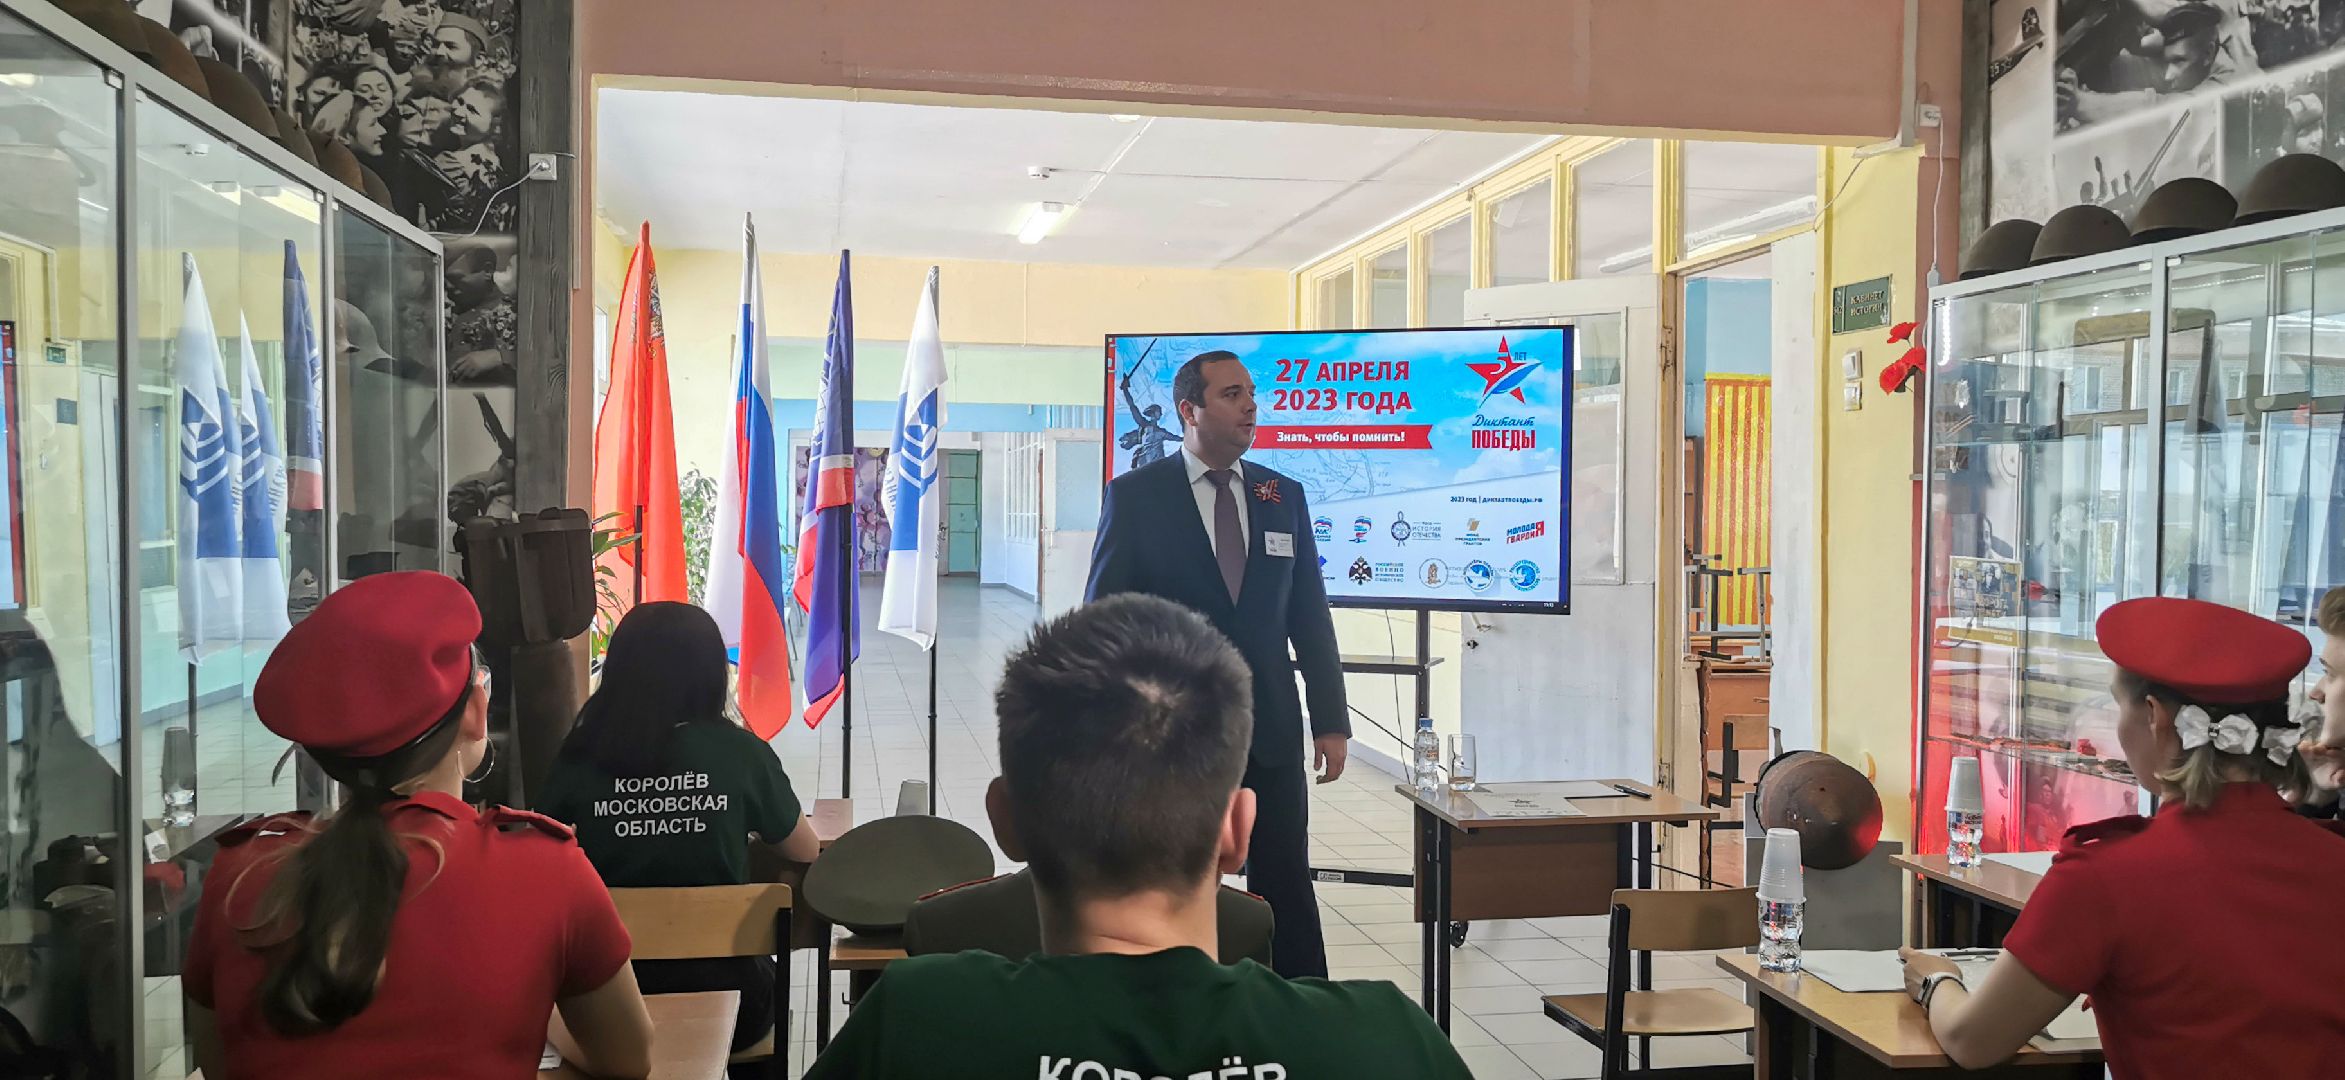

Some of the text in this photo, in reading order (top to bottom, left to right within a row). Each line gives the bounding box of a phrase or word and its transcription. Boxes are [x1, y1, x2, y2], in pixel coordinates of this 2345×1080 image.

[1850, 290, 1884, 304] КАБИНЕТ
[1513, 352, 1527, 361] ЛЕТ
[1275, 359, 1410, 383] 27 АПРЕЛЯ
[1273, 388, 1413, 415] 2023 ГОДА
[1472, 414, 1535, 427] Диктант
[1277, 431, 1405, 443] Знать, чтобы помнить!
[1472, 430, 1535, 451] ПОБЕДЫ
[614, 771, 709, 793] КОРОЛЁВ
[594, 795, 728, 817] МОСКОВСКАЯ
[614, 817, 707, 838] ОБЛАСТЬ
